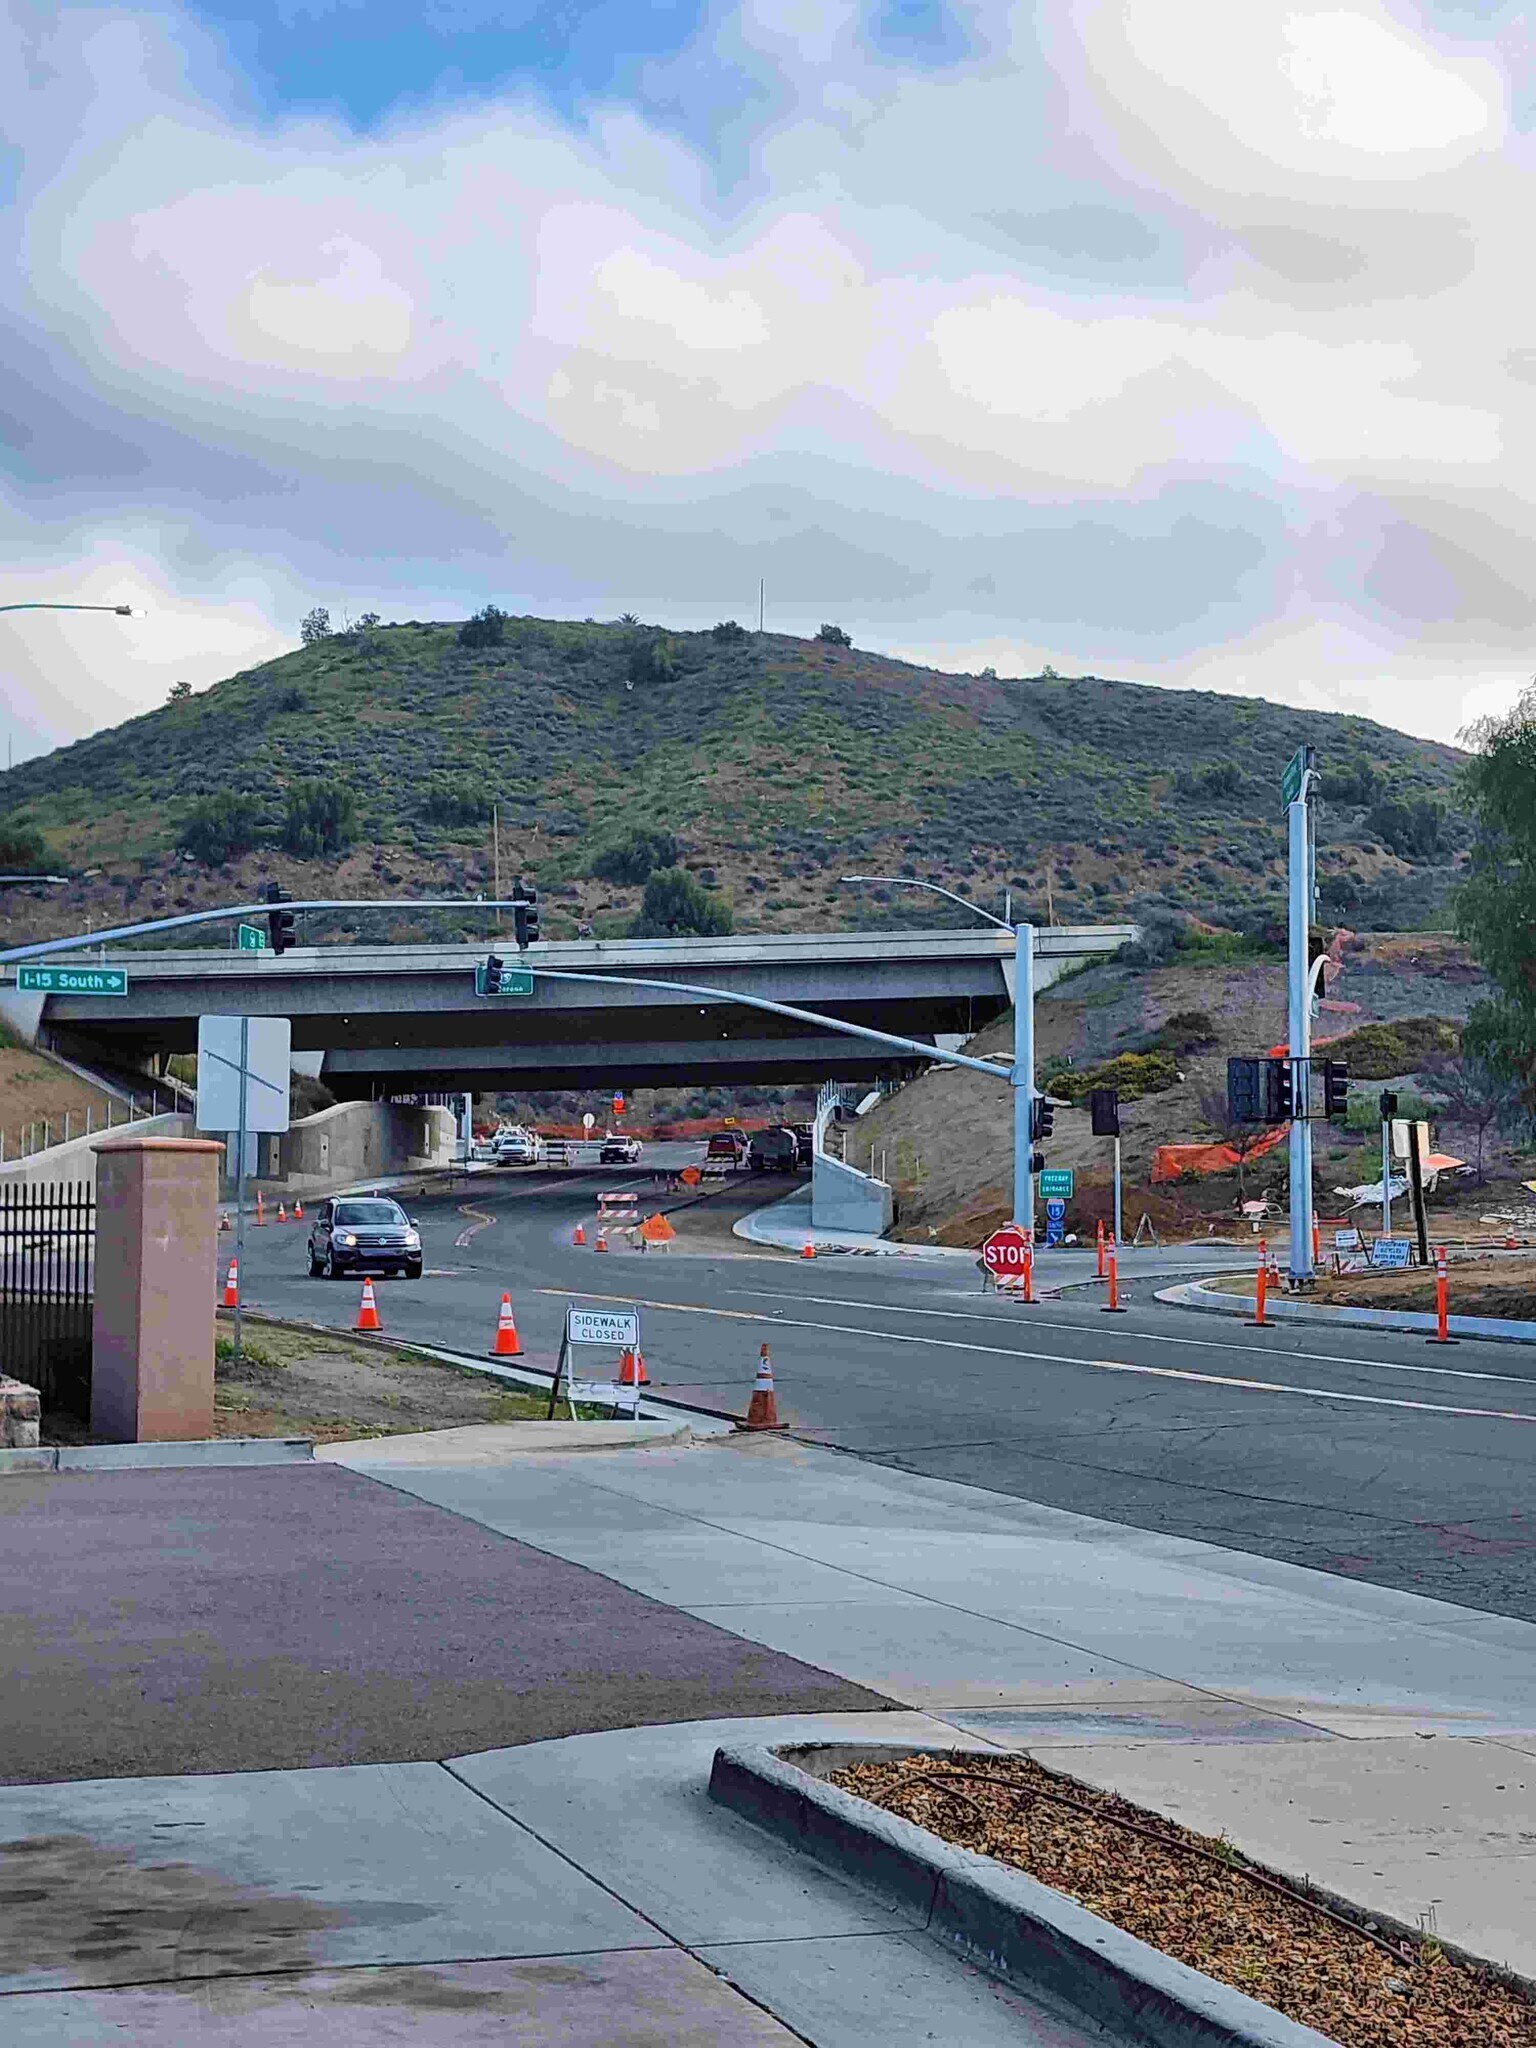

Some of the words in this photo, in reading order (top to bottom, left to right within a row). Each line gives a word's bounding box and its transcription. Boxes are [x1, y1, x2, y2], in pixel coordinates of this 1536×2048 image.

[24, 973, 52, 987] I-15
[59, 973, 104, 988] South
[1051, 1206, 1060, 1216] 15
[574, 1314, 631, 1329] SIDEWALK
[581, 1328, 625, 1340] CLOSED
